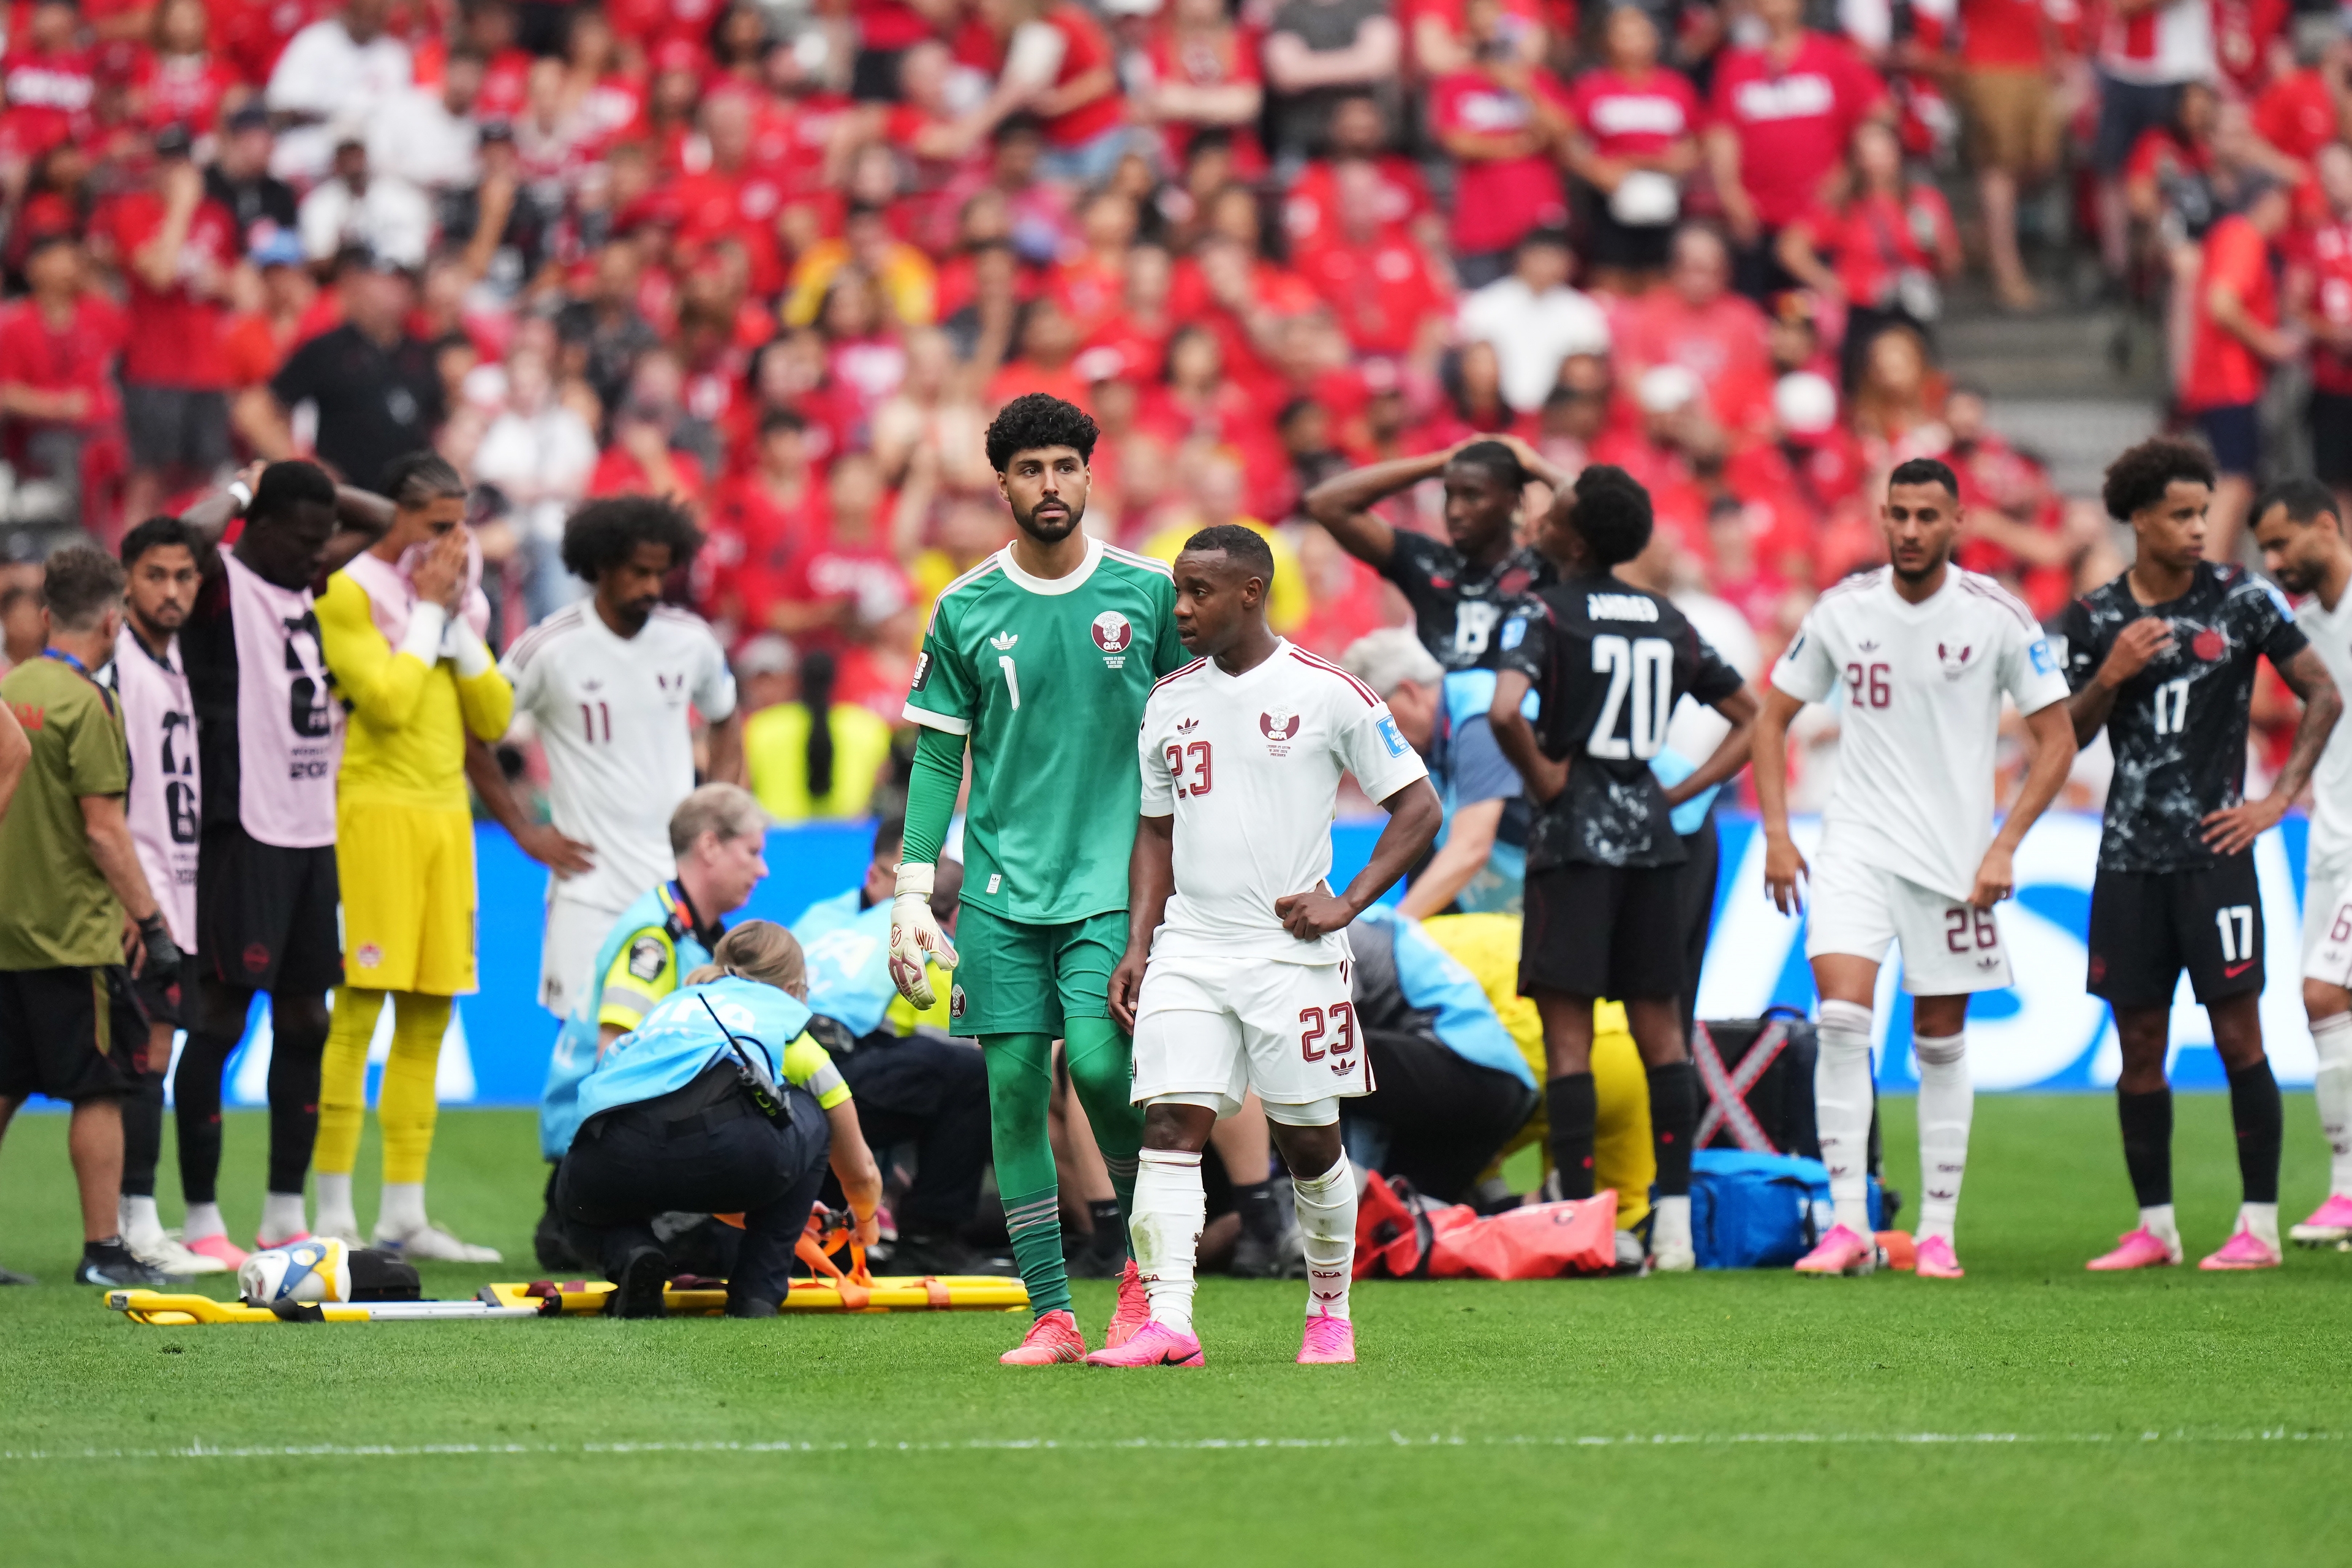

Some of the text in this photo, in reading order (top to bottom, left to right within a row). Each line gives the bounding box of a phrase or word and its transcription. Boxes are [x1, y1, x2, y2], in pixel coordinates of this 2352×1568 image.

[1103, 641, 1122, 650] QFA
[998, 655, 1021, 712] 1
[1586, 635, 1675, 761] 20
[1847, 663, 1891, 709] 26
[2154, 678, 2190, 735] 17
[580, 702, 610, 744] 11
[1267, 730, 1287, 740] QFA
[1166, 741, 1215, 801] 23
[1946, 908, 1997, 952] 26
[2216, 905, 2253, 962] 17
[1299, 1001, 1355, 1065] 23
